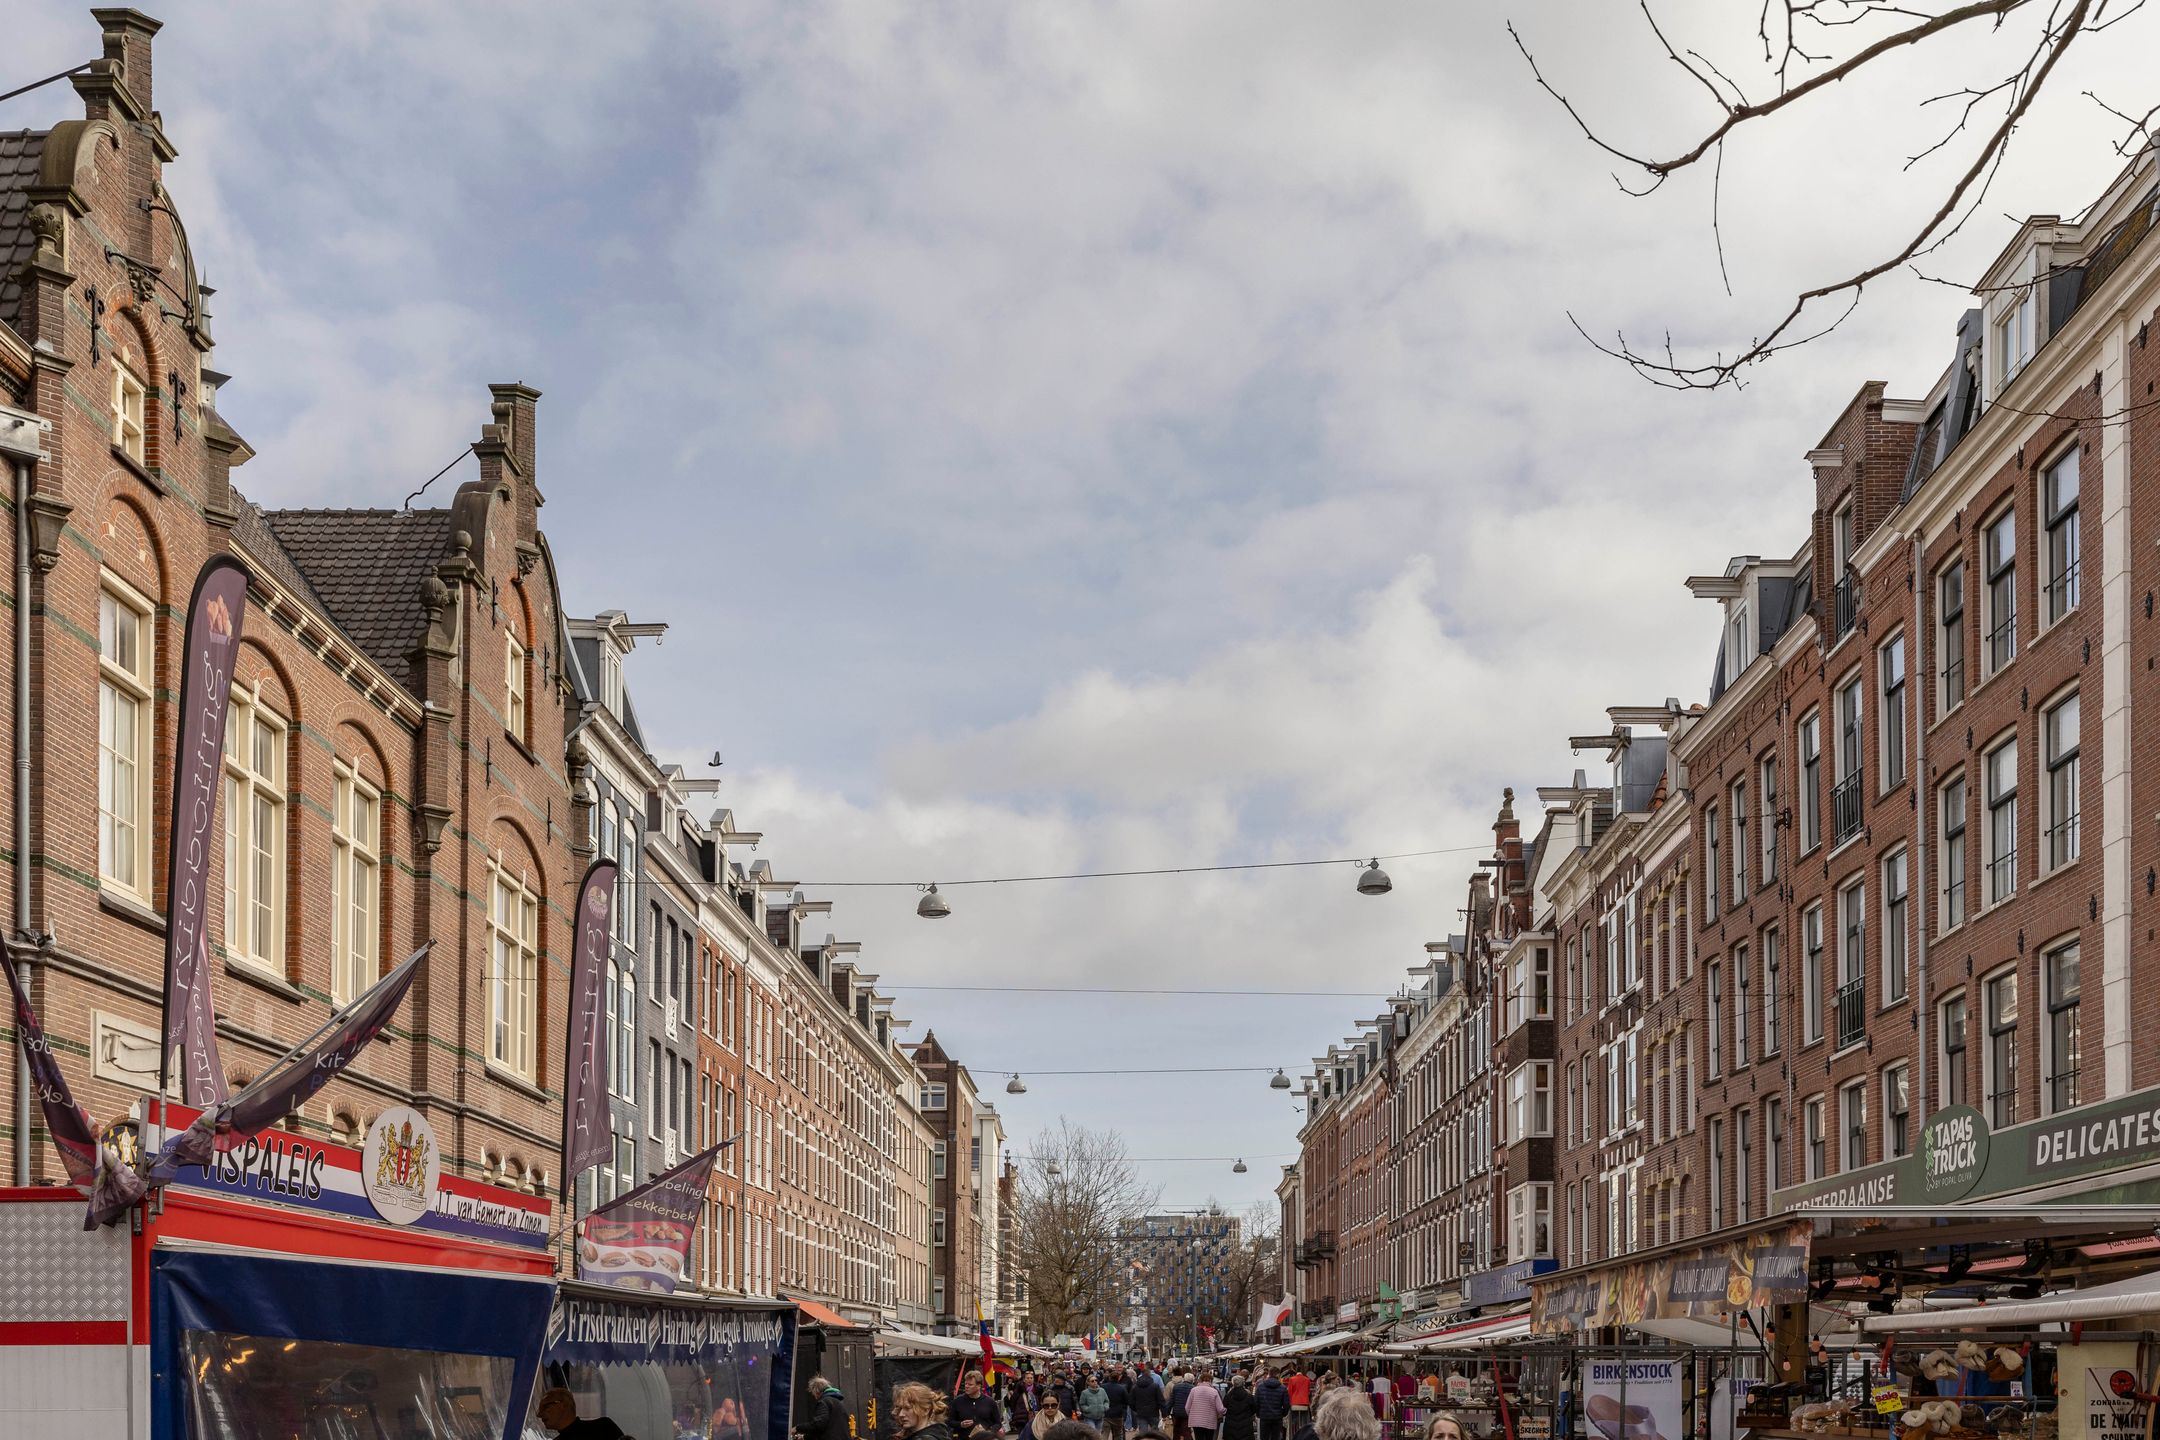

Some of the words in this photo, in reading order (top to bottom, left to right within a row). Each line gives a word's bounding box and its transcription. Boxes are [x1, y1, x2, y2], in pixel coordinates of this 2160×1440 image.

[1935, 1115, 1973, 1149] TAPAS
[1933, 1140, 1977, 1175] TRUCK
[1785, 1174, 1895, 1212] RRAANSE
[435, 1188, 453, 1218] J.T.
[457, 1200, 473, 1221] van
[475, 1196, 505, 1227] Gemert
[507, 1212, 518, 1232] en
[519, 1208, 542, 1235] Zonen
[566, 1302, 647, 1344] Frisdranken
[662, 1309, 696, 1355] Haring
[709, 1312, 741, 1353] Belegde
[743, 1312, 775, 1350] broodjes
[1593, 1364, 1672, 1379] BIRKNSTOCK
[2091, 1414, 2106, 1428] DE
